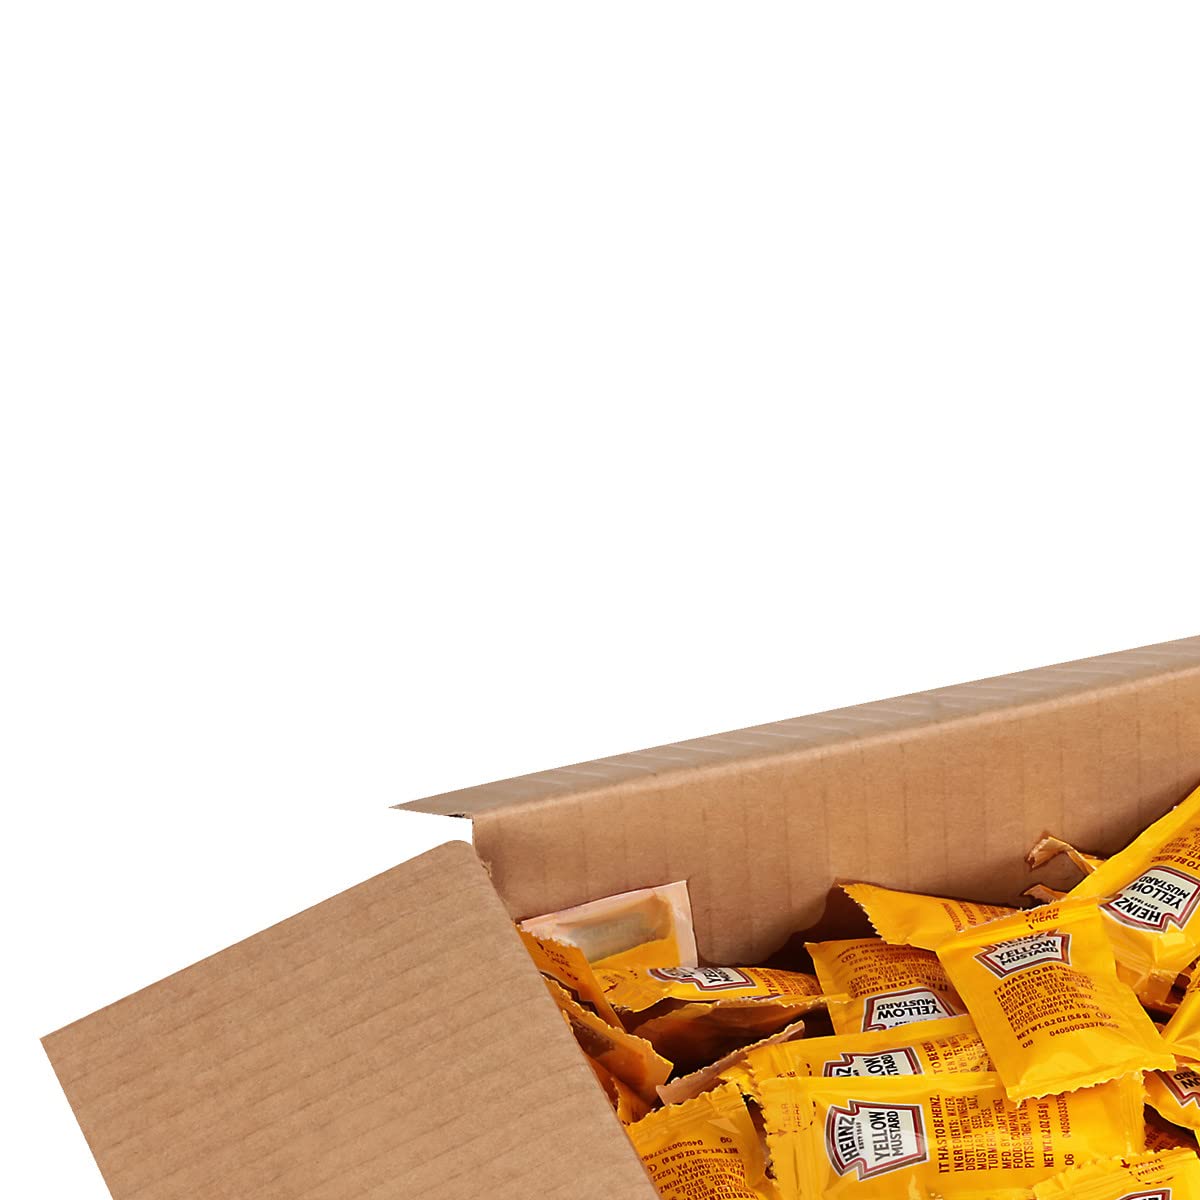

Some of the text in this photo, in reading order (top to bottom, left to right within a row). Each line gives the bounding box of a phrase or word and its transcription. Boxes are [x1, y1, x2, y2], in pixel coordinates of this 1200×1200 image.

[1187, 860, 1200, 870] TO
[1127, 882, 1182, 910] YELLOW
[1139, 876, 1190, 899] MUSTARD
[1115, 897, 1161, 922] HEINZ
[995, 940, 1056, 960] YELLOW
[1001, 947, 1058, 965] MUSTARD
[1004, 974, 1025, 988] HAS
[1027, 970, 1040, 978] TO
[1042, 965, 1056, 973] BE
[877, 998, 936, 1011] MUSTARD
[1041, 994, 1067, 1004] KRAFT
[878, 1006, 941, 1020] YELLOW
[1016, 1029, 1030, 1040] NET
[1031, 1024, 1044, 1032] WT.
[1044, 1019, 1056, 1027] 0.2
[887, 1110, 904, 1156] MUSTARD
[933, 1119, 944, 1128] BE
[838, 1116, 860, 1162] HEINZ
[869, 1111, 890, 1162] YELLOW
[935, 1129, 946, 1138] TO
[937, 1139, 949, 1161] HAS
[1064, 1153, 1075, 1166] 06
[939, 1163, 950, 1173] IT
[1044, 1153, 1054, 1168] NET
